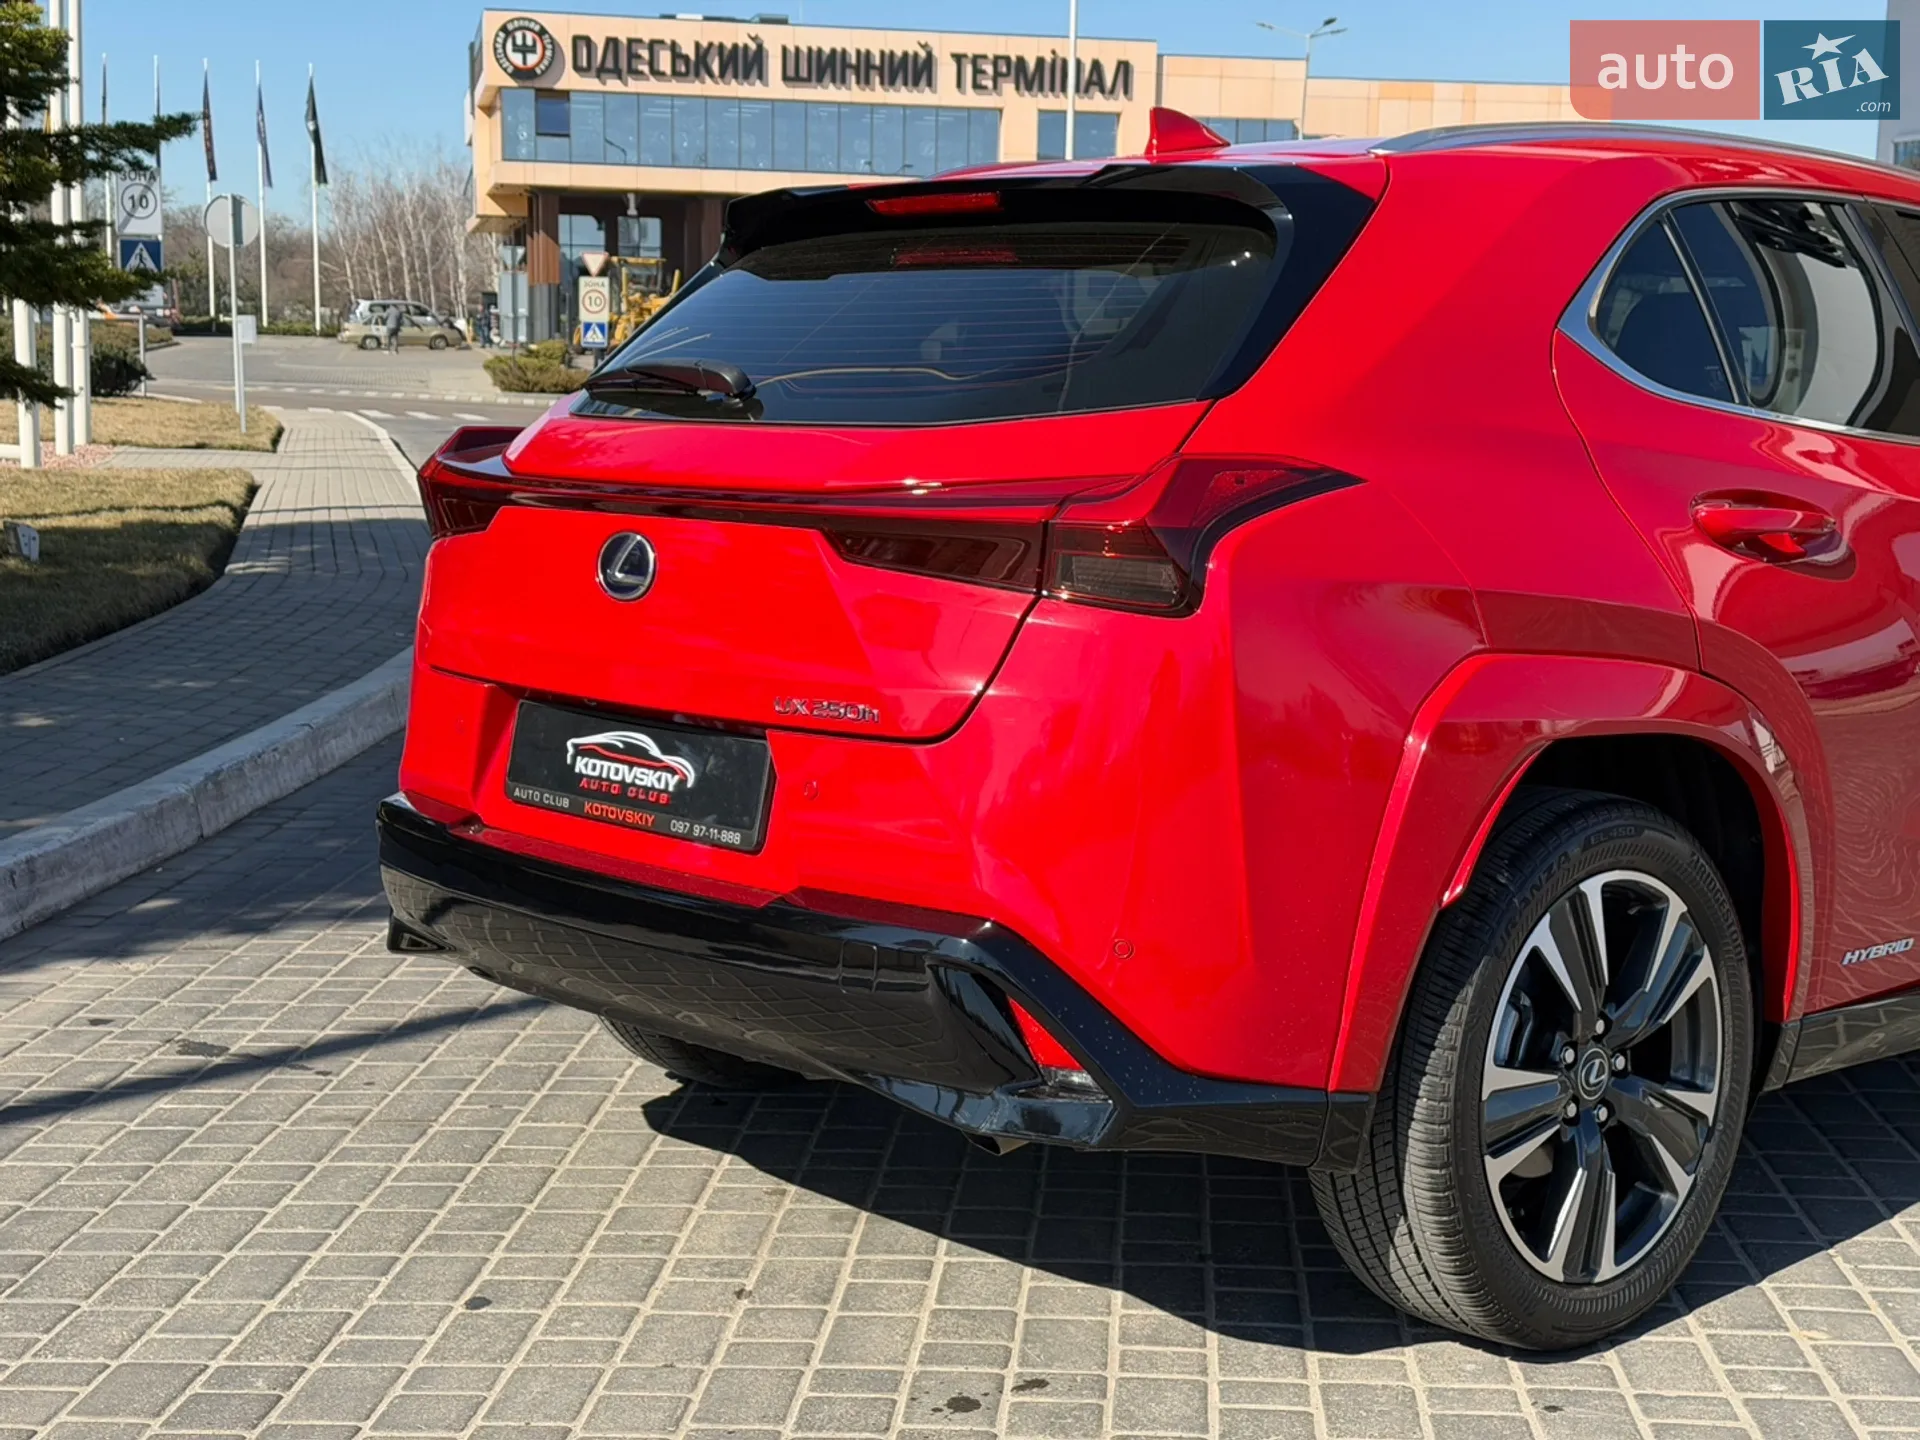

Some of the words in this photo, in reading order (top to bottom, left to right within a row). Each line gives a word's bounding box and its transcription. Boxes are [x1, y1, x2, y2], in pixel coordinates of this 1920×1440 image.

[570, 33, 763, 81] ОДЕСЬКИЙ
[781, 41, 932, 90] ШИННИЙ
[128, 194, 149, 209] 10
[588, 296, 603, 307] 10
[774, 697, 809, 715] UX
[574, 756, 680, 792] KOTOVSKIY
[513, 787, 541, 802] AUTO
[543, 793, 570, 808] CLUB
[579, 778, 621, 795] AUTO
[627, 788, 671, 805] CLUB
[583, 801, 656, 827] KOTOVSKIY
[670, 819, 690, 834] 097
[692, 824, 741, 845] 97-11-888
[1842, 937, 1915, 966] HYBRID
